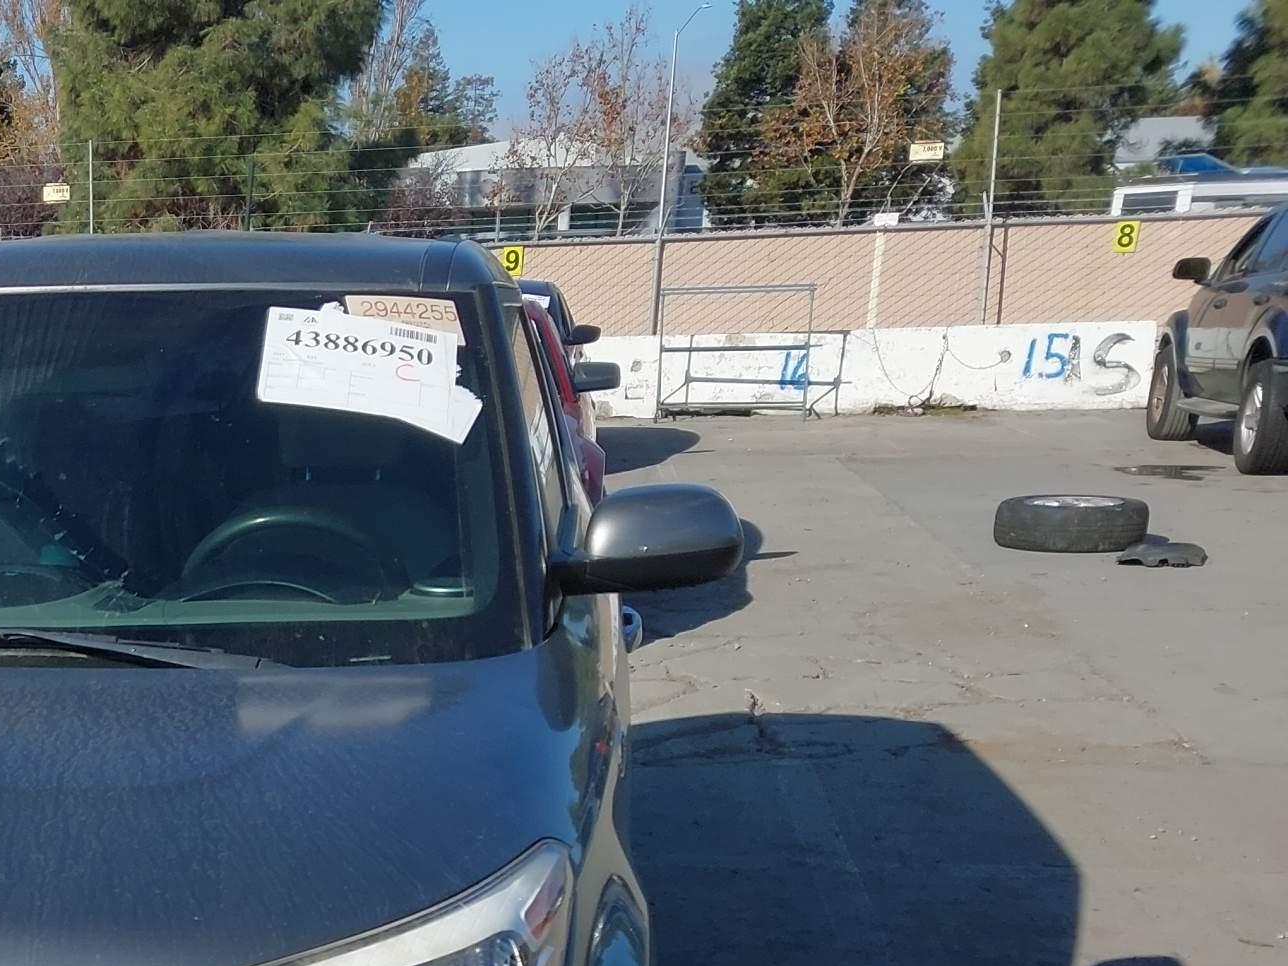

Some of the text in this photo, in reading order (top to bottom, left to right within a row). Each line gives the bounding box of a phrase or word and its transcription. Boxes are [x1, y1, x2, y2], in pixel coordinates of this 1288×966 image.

[1117, 223, 1135, 248] 8
[505, 249, 520, 272] 9
[360, 300, 457, 322] 2944255
[286, 329, 433, 366] 43886950
